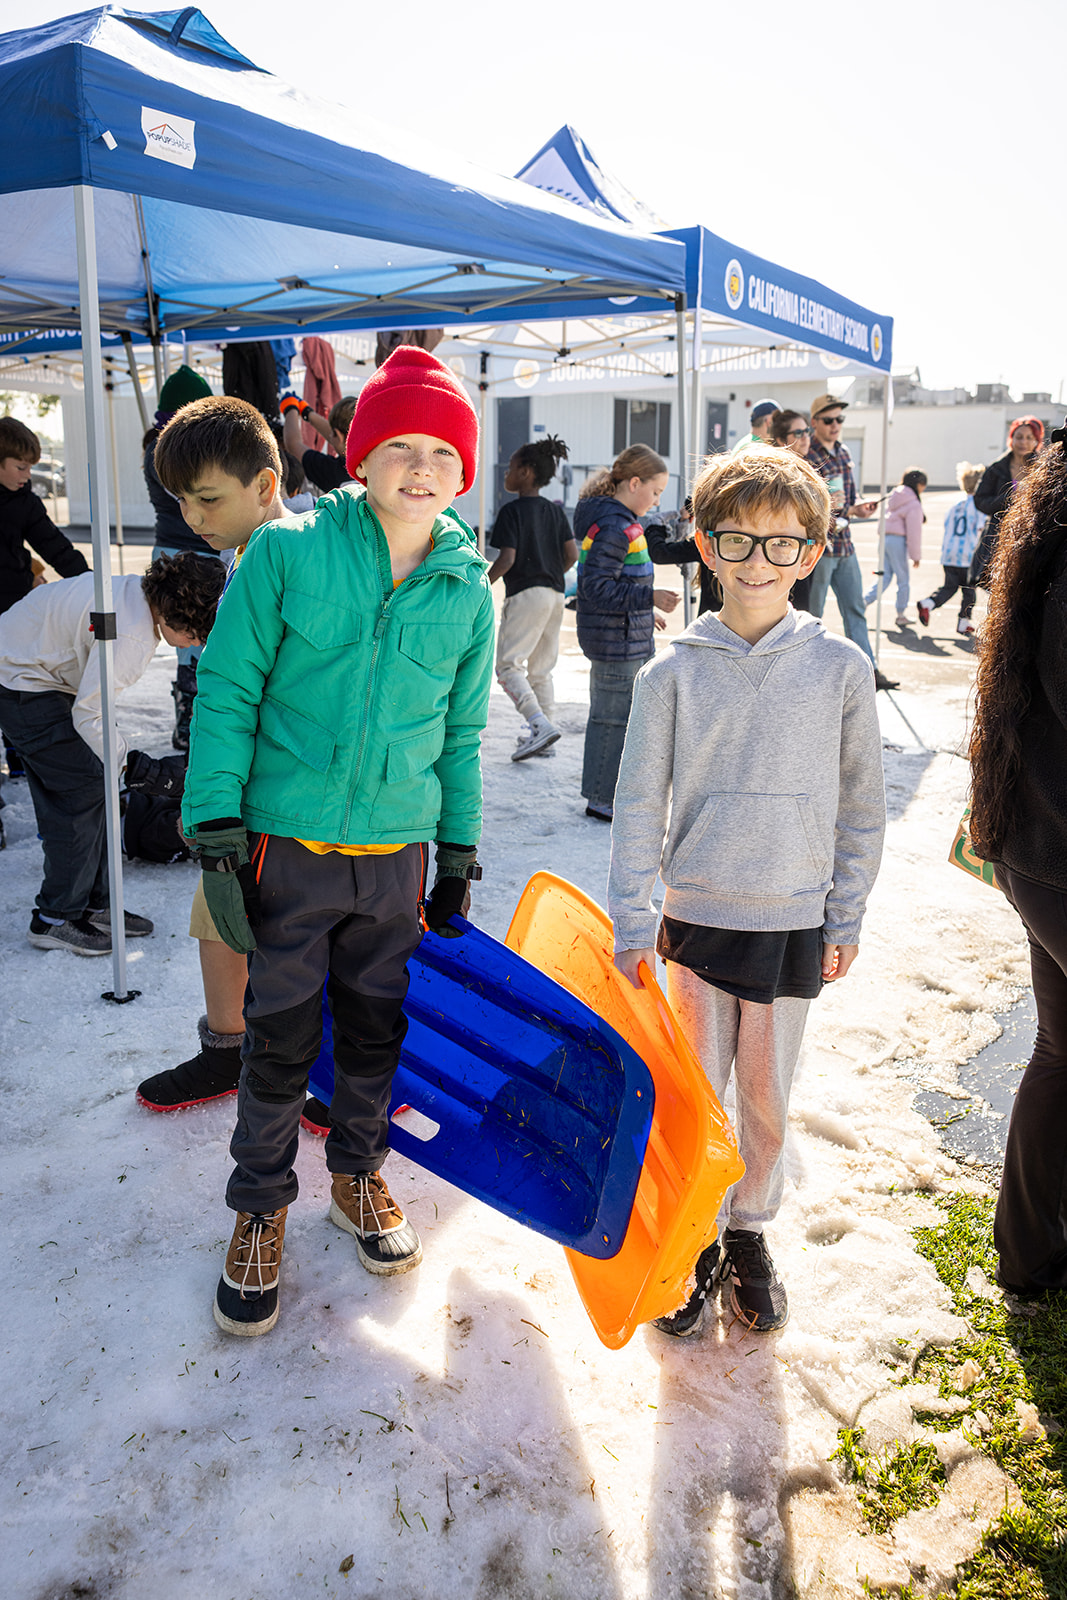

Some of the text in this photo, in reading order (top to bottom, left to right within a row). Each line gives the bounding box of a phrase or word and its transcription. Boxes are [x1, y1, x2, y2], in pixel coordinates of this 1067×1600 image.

[748, 274, 870, 353] CALIFORNIA ELEMENTARY SCHOOL
